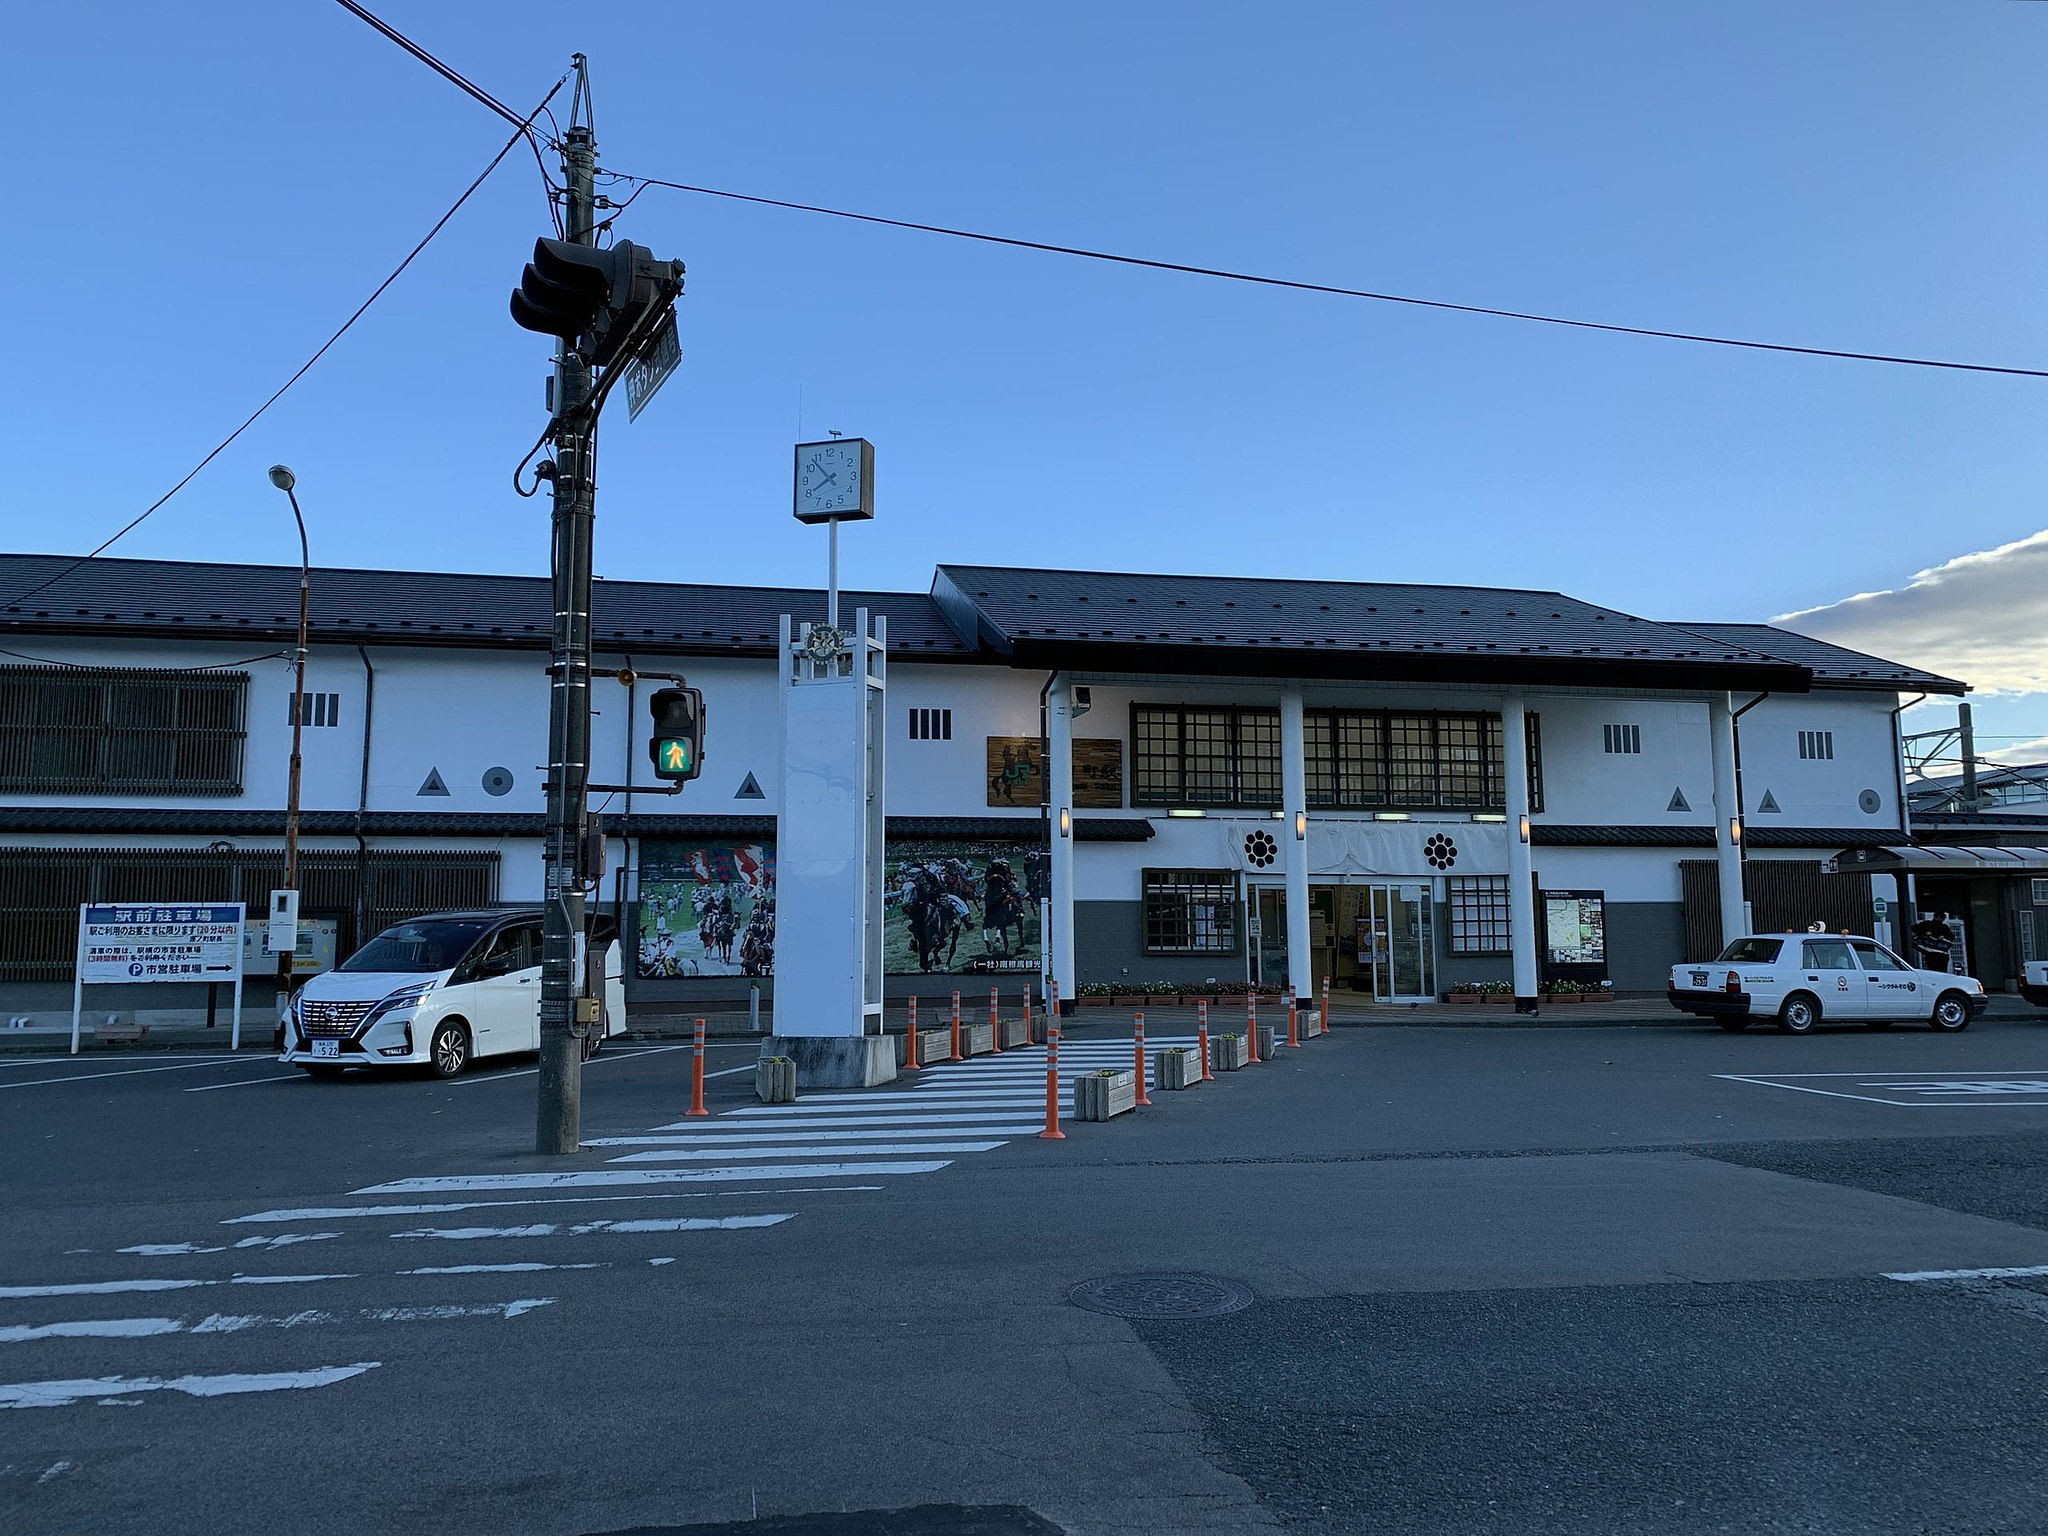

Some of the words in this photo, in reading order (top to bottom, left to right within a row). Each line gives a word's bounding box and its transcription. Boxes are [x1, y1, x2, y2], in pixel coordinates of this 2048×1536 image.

[825, 448, 835, 457] 12
[814, 453, 822, 462] 11
[846, 458, 853, 467] 2
[805, 464, 815, 473] 10
[802, 476, 809, 486] 9
[850, 472, 857, 481] 3
[805, 489, 812, 498] 8
[847, 486, 853, 494] 4
[815, 498, 822, 507] 7
[837, 495, 844, 504] 5
[826, 500, 832, 509] 6
[1005, 763, 1031, 779] JR
[114, 909, 213, 923] 駅前駐車場
[146, 963, 203, 975] 市営駐車場
